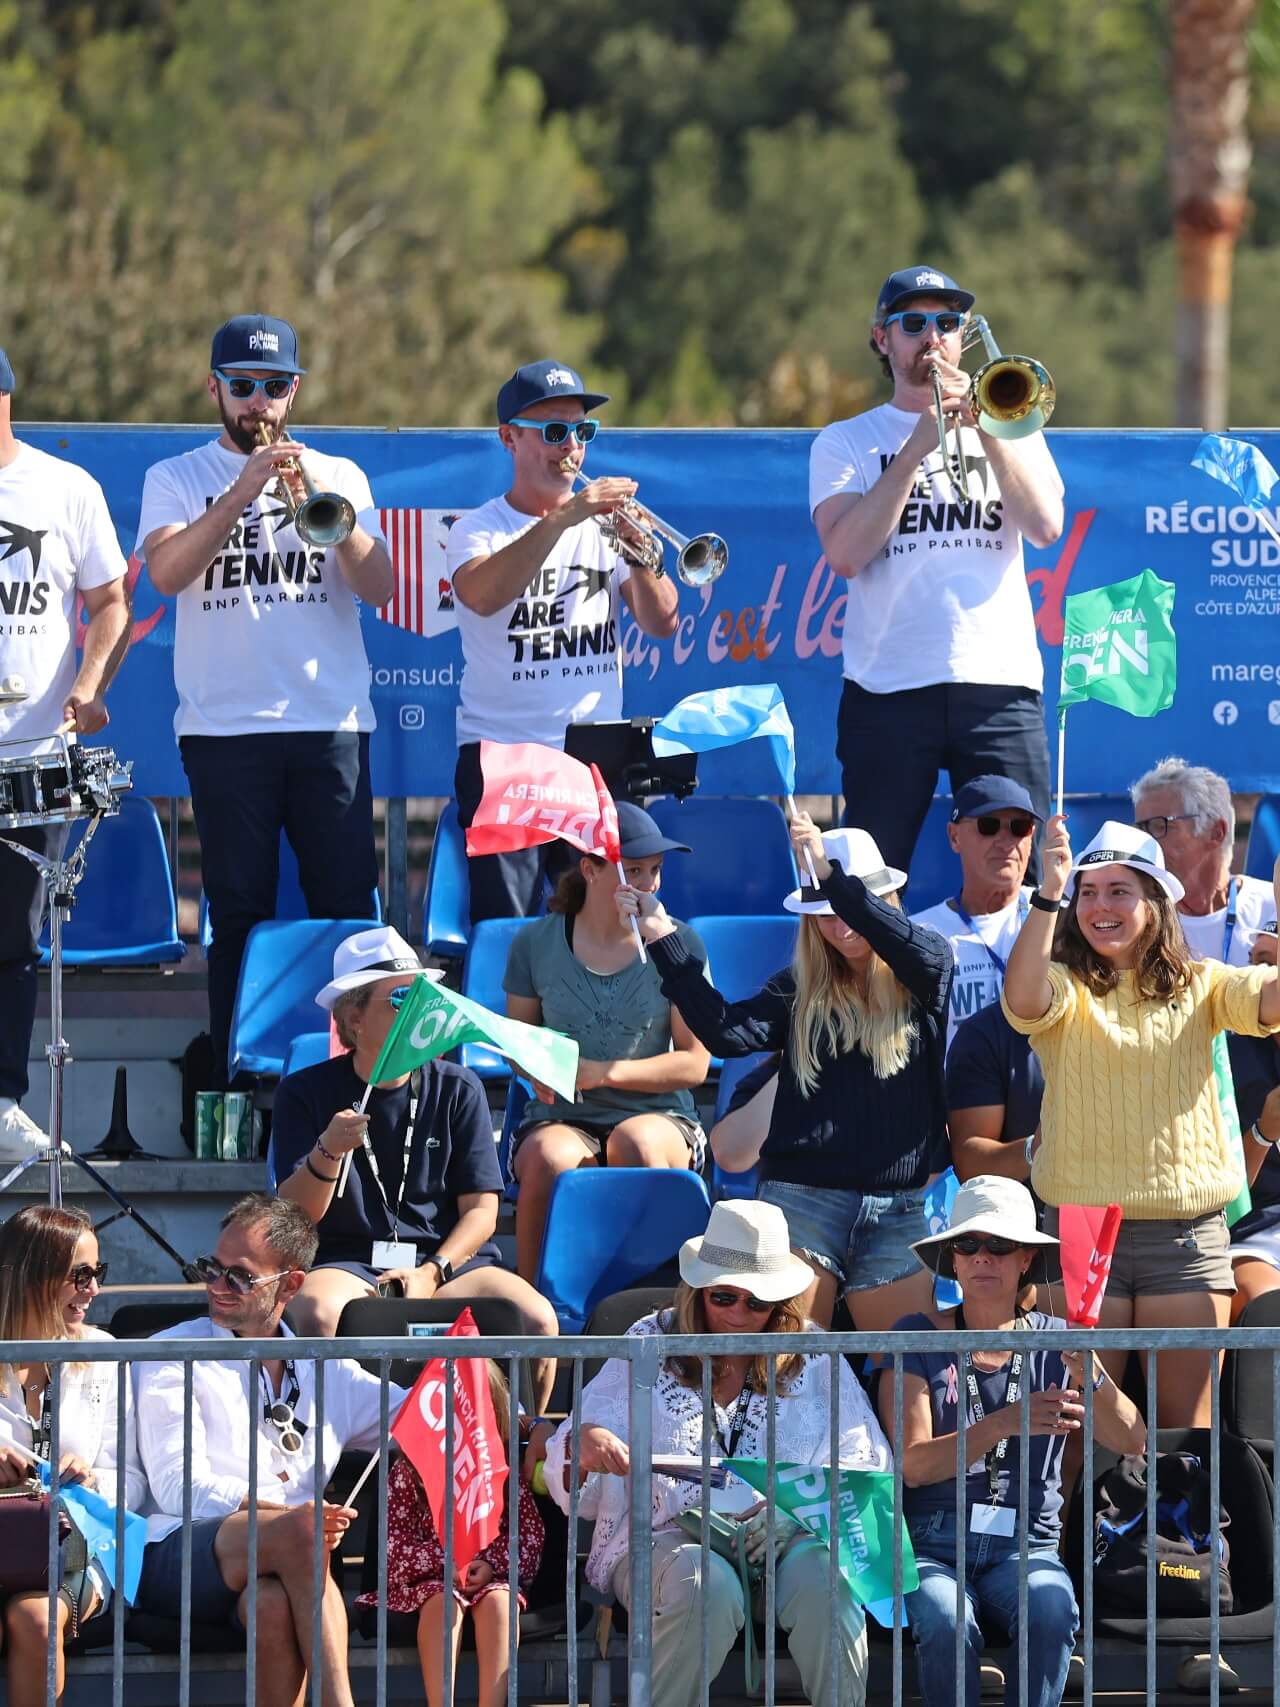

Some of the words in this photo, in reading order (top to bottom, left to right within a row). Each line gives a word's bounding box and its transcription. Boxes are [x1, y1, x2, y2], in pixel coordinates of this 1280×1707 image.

[899, 500, 1003, 535] ENNIS
[929, 539, 1003, 550] PARIBAS
[204, 552, 325, 592] TENNIS
[0, 581, 50, 615] NIS
[203, 598, 240, 611] BNP
[507, 600, 565, 630] ARE
[1195, 600, 1232, 617] CÔTE
[508, 619, 616, 663] TENNIS
[512, 669, 550, 681] BNP
[1089, 851, 1114, 862] OPEN
[1011, 1354, 1022, 1375] OPEN
[1007, 1383, 1018, 1403] OPEN
